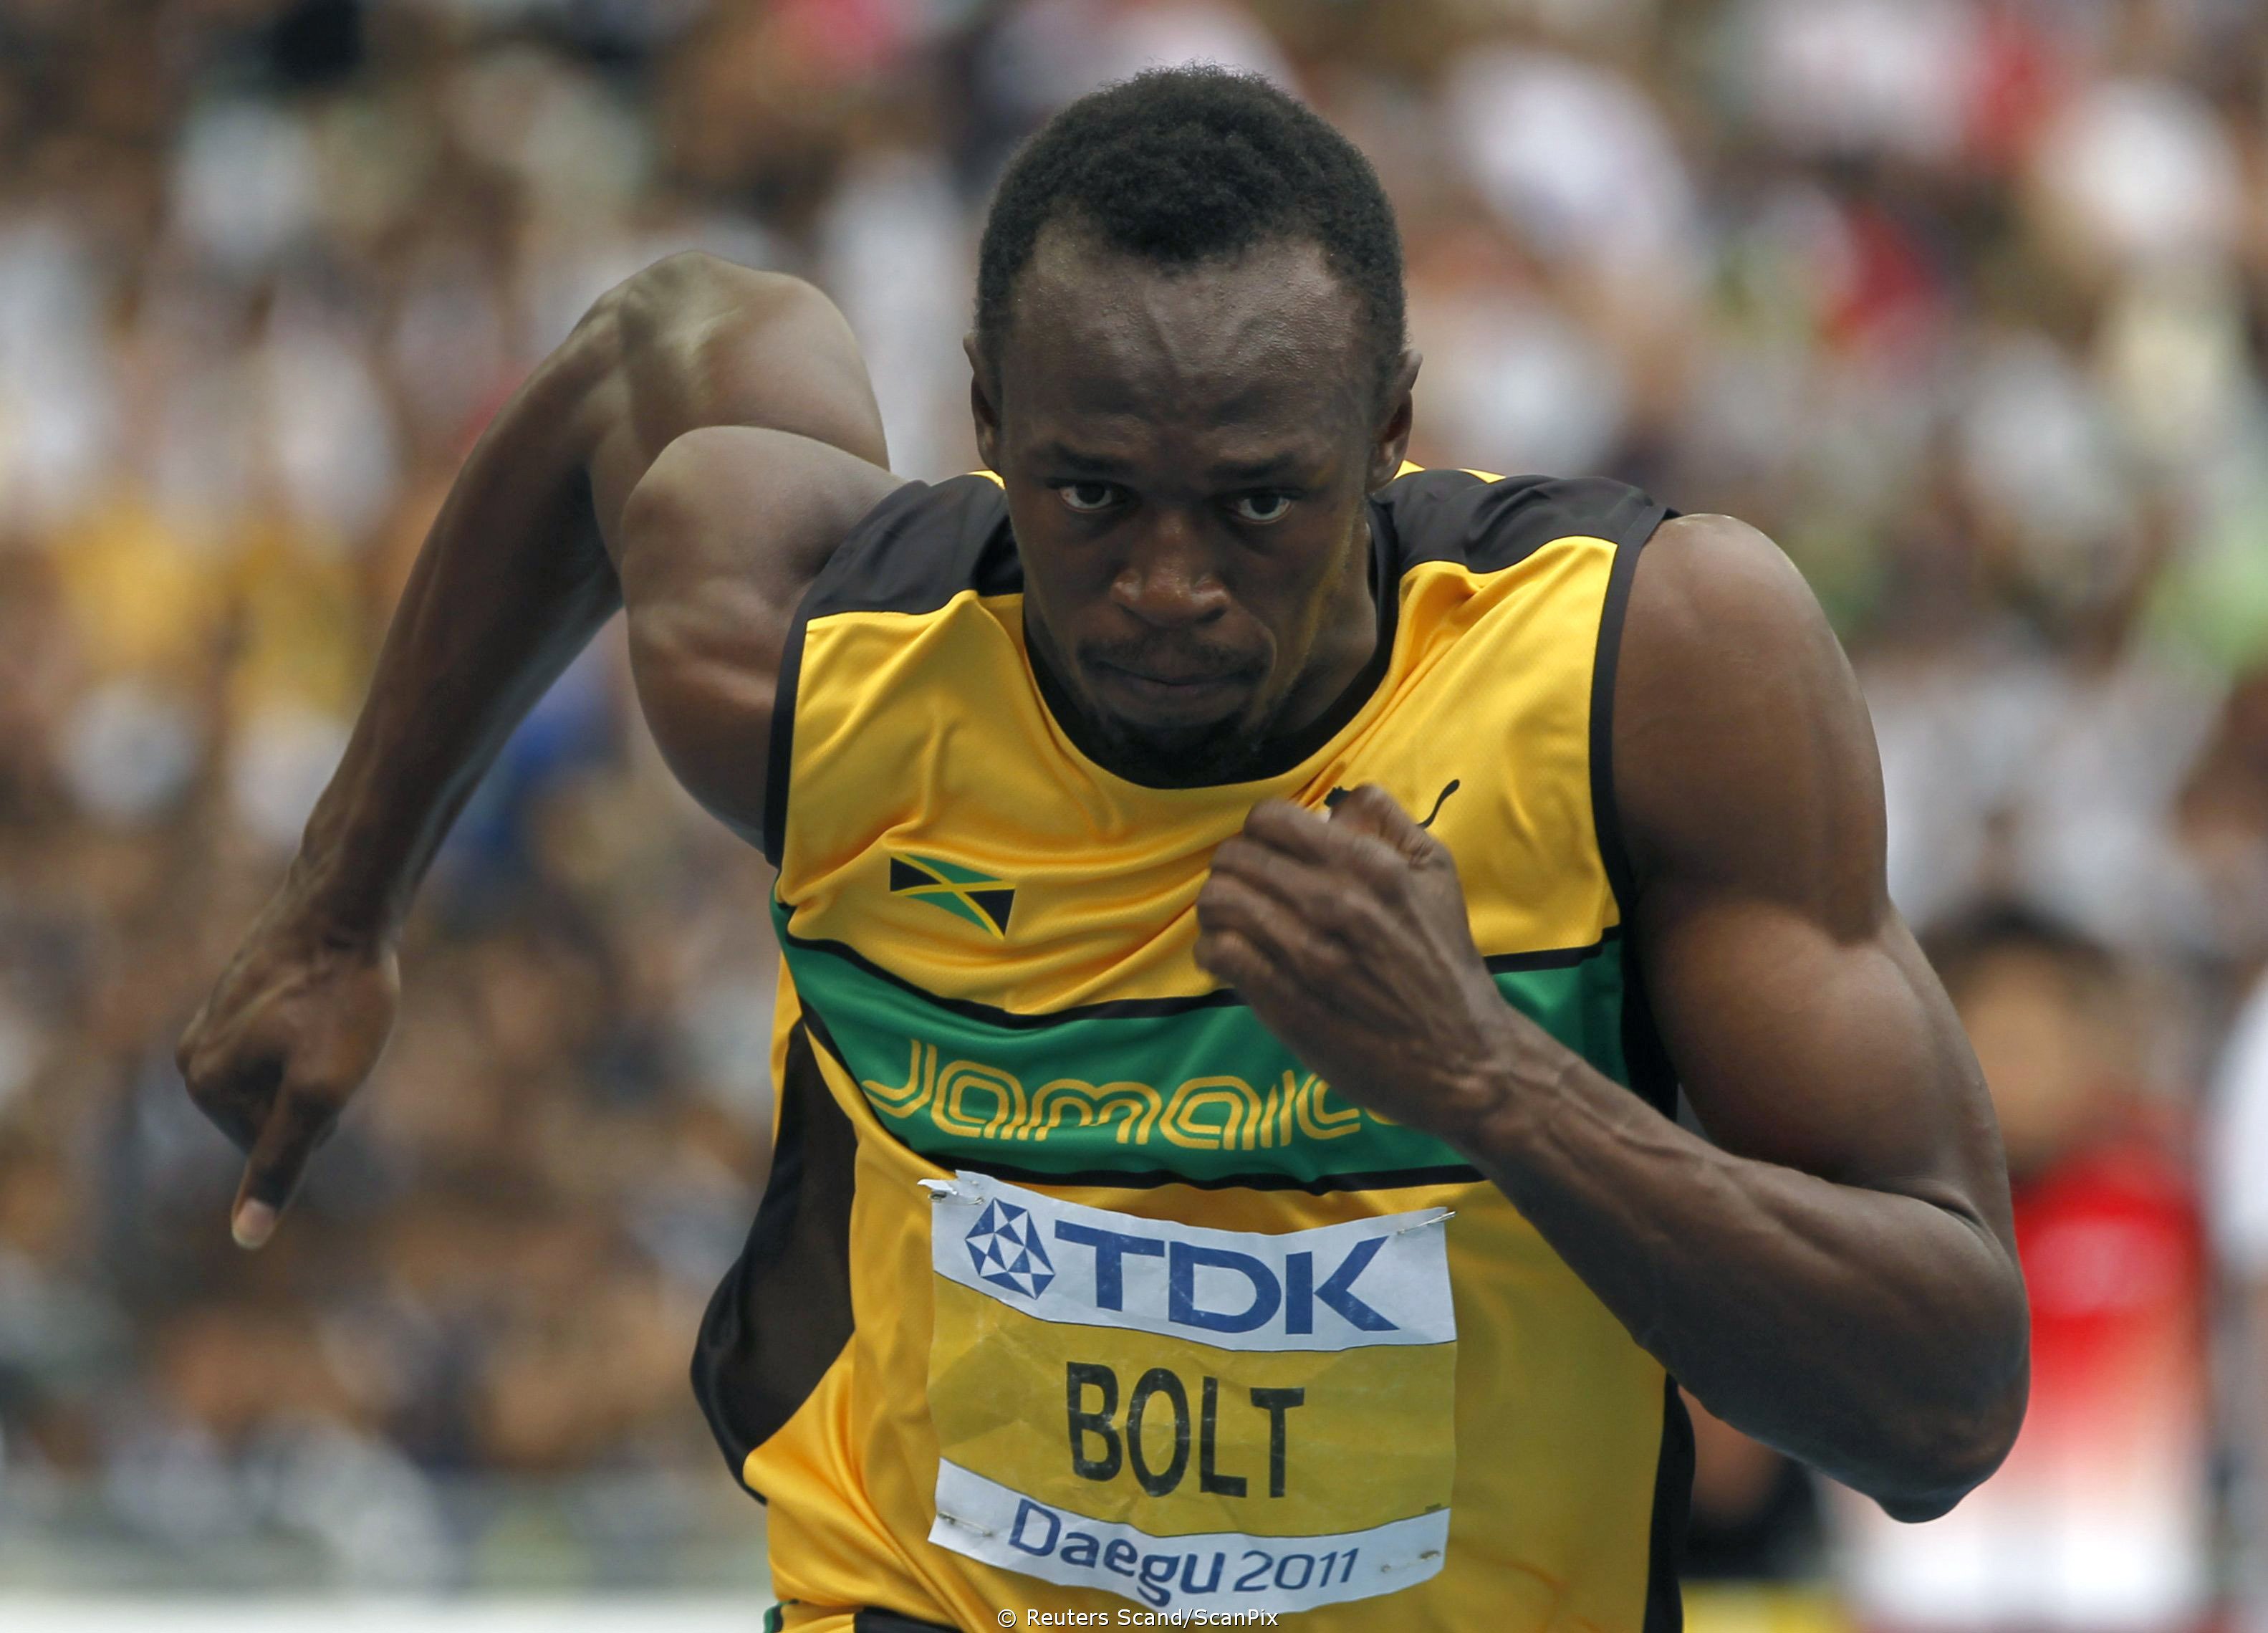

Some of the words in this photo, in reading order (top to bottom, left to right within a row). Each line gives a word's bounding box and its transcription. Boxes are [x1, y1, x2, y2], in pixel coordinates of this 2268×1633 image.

[862, 1039, 1399, 1151] Jamaic
[1054, 1220, 1400, 1335] TDK
[1066, 1361, 1305, 1498] BOLT
[1008, 1498, 1224, 1607] Daegu
[1234, 1546, 1360, 1593] 2011
